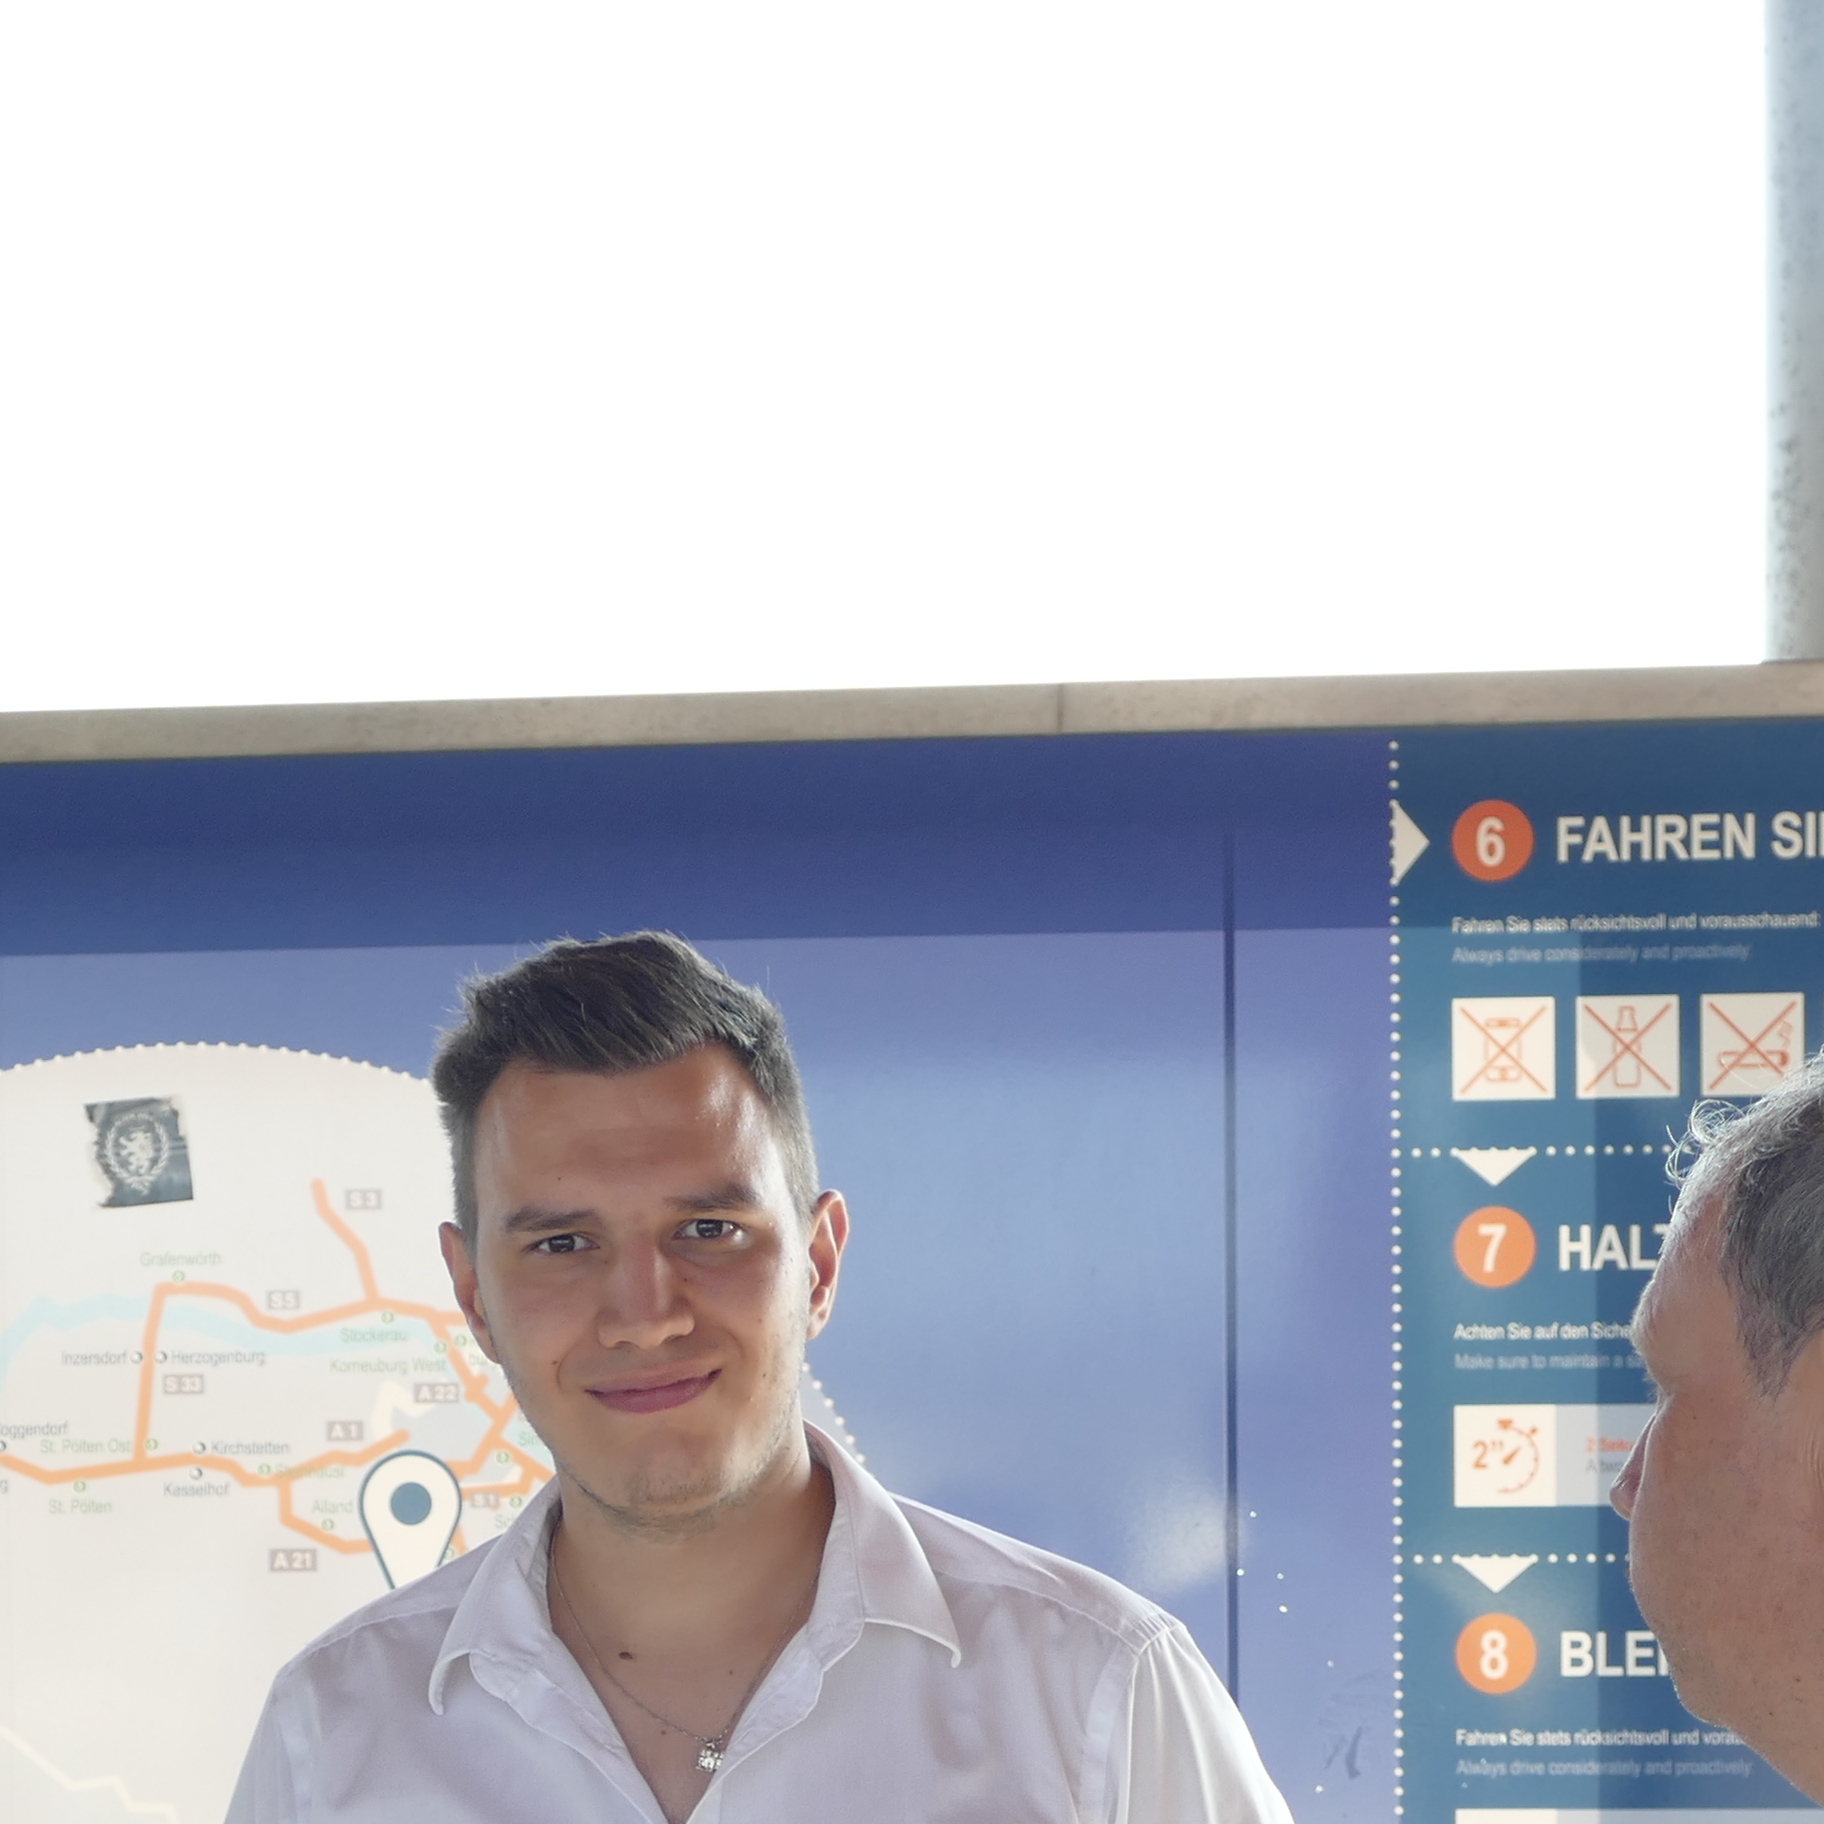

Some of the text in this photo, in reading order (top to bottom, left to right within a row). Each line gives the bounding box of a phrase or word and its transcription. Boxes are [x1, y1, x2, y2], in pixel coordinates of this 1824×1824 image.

[1476, 816, 1506, 867] 6
[1556, 812, 1757, 863] FAHREN
[1506, 915, 1531, 934] Sie
[1667, 912, 1697, 931] und
[1478, 1223, 1507, 1274] 7
[1507, 1321, 1531, 1341] Sie
[1533, 1321, 1559, 1341] auf
[1479, 1630, 1509, 1681] 8
[1509, 1727, 1534, 1746] Sie
[1671, 1728, 1700, 1745] und
